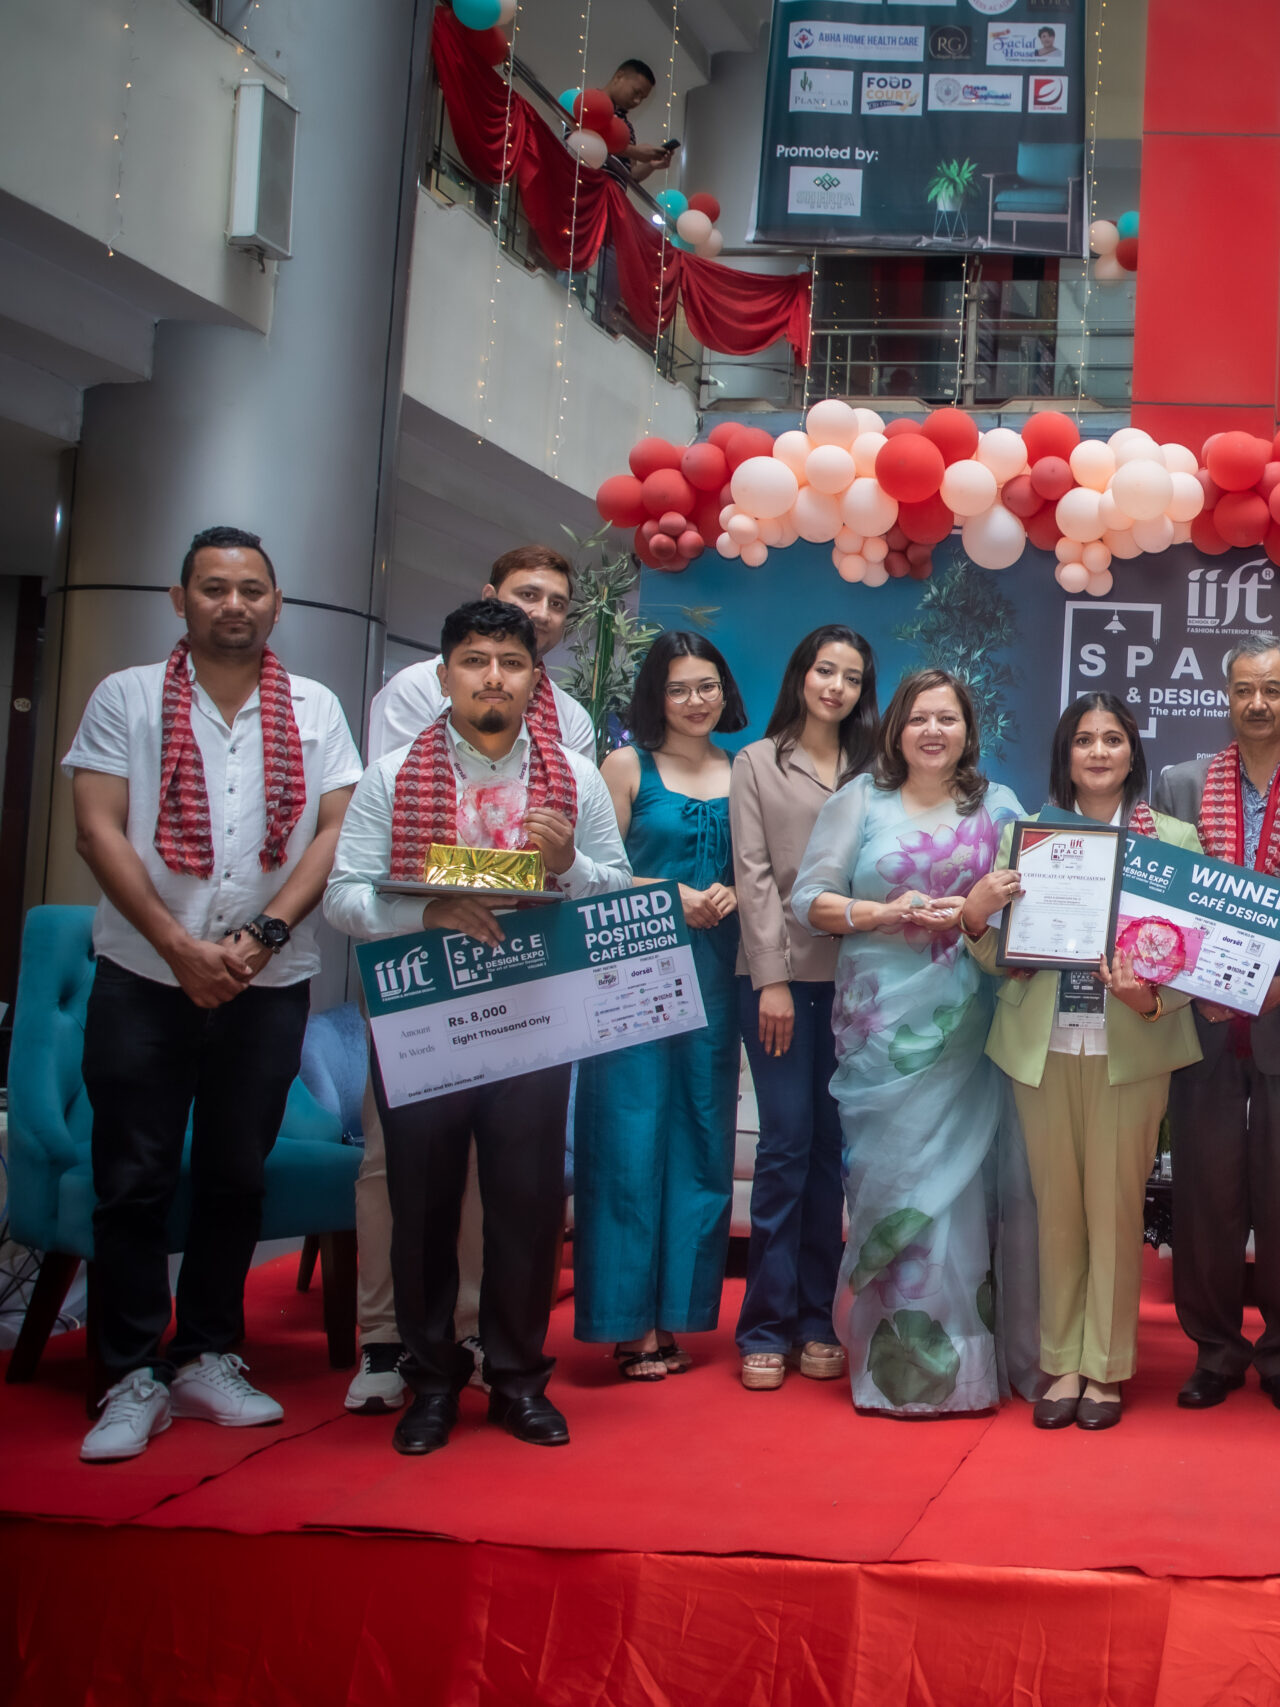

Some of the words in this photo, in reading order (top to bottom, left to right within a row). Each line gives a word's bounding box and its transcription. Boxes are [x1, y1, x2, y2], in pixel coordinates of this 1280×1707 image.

[842, 33, 865, 45] HOME
[867, 35, 896, 46] HEALTH
[898, 36, 919, 46] CARE
[937, 37, 961, 54] RG
[867, 76, 912, 89] FOOD
[866, 90, 912, 100] COURT
[776, 145, 850, 159] Promoted
[855, 147, 879, 163] by:
[1078, 643, 1232, 680] SPA
[1126, 687, 1141, 704] &
[1149, 688, 1229, 706] DESIGN
[1150, 707, 1168, 716] The
[1171, 708, 1186, 717] art
[1190, 707, 1201, 717] of
[1124, 854, 1175, 879] ACE
[1149, 874, 1169, 886] EXPO
[577, 889, 672, 930] THIRD
[1188, 892, 1225, 912] CAFÉ
[1226, 903, 1279, 929] DESIGN
[585, 915, 676, 949] POSITION
[454, 934, 543, 965] SPACE
[589, 942, 626, 963] CAFÉ
[628, 933, 678, 955] DESIGN
[476, 963, 483, 971] &
[485, 955, 519, 969] DESIGN
[520, 949, 545, 960] EXPO
[400, 1025, 431, 1039] Amount
[448, 1016, 468, 1027] Rs.
[471, 1005, 507, 1021] 8,000
[399, 1051, 407, 1060] In
[409, 1044, 435, 1057] Words
[452, 1033, 477, 1045] Eight
[479, 1019, 527, 1039] Thousand
[529, 1015, 551, 1027] Only
